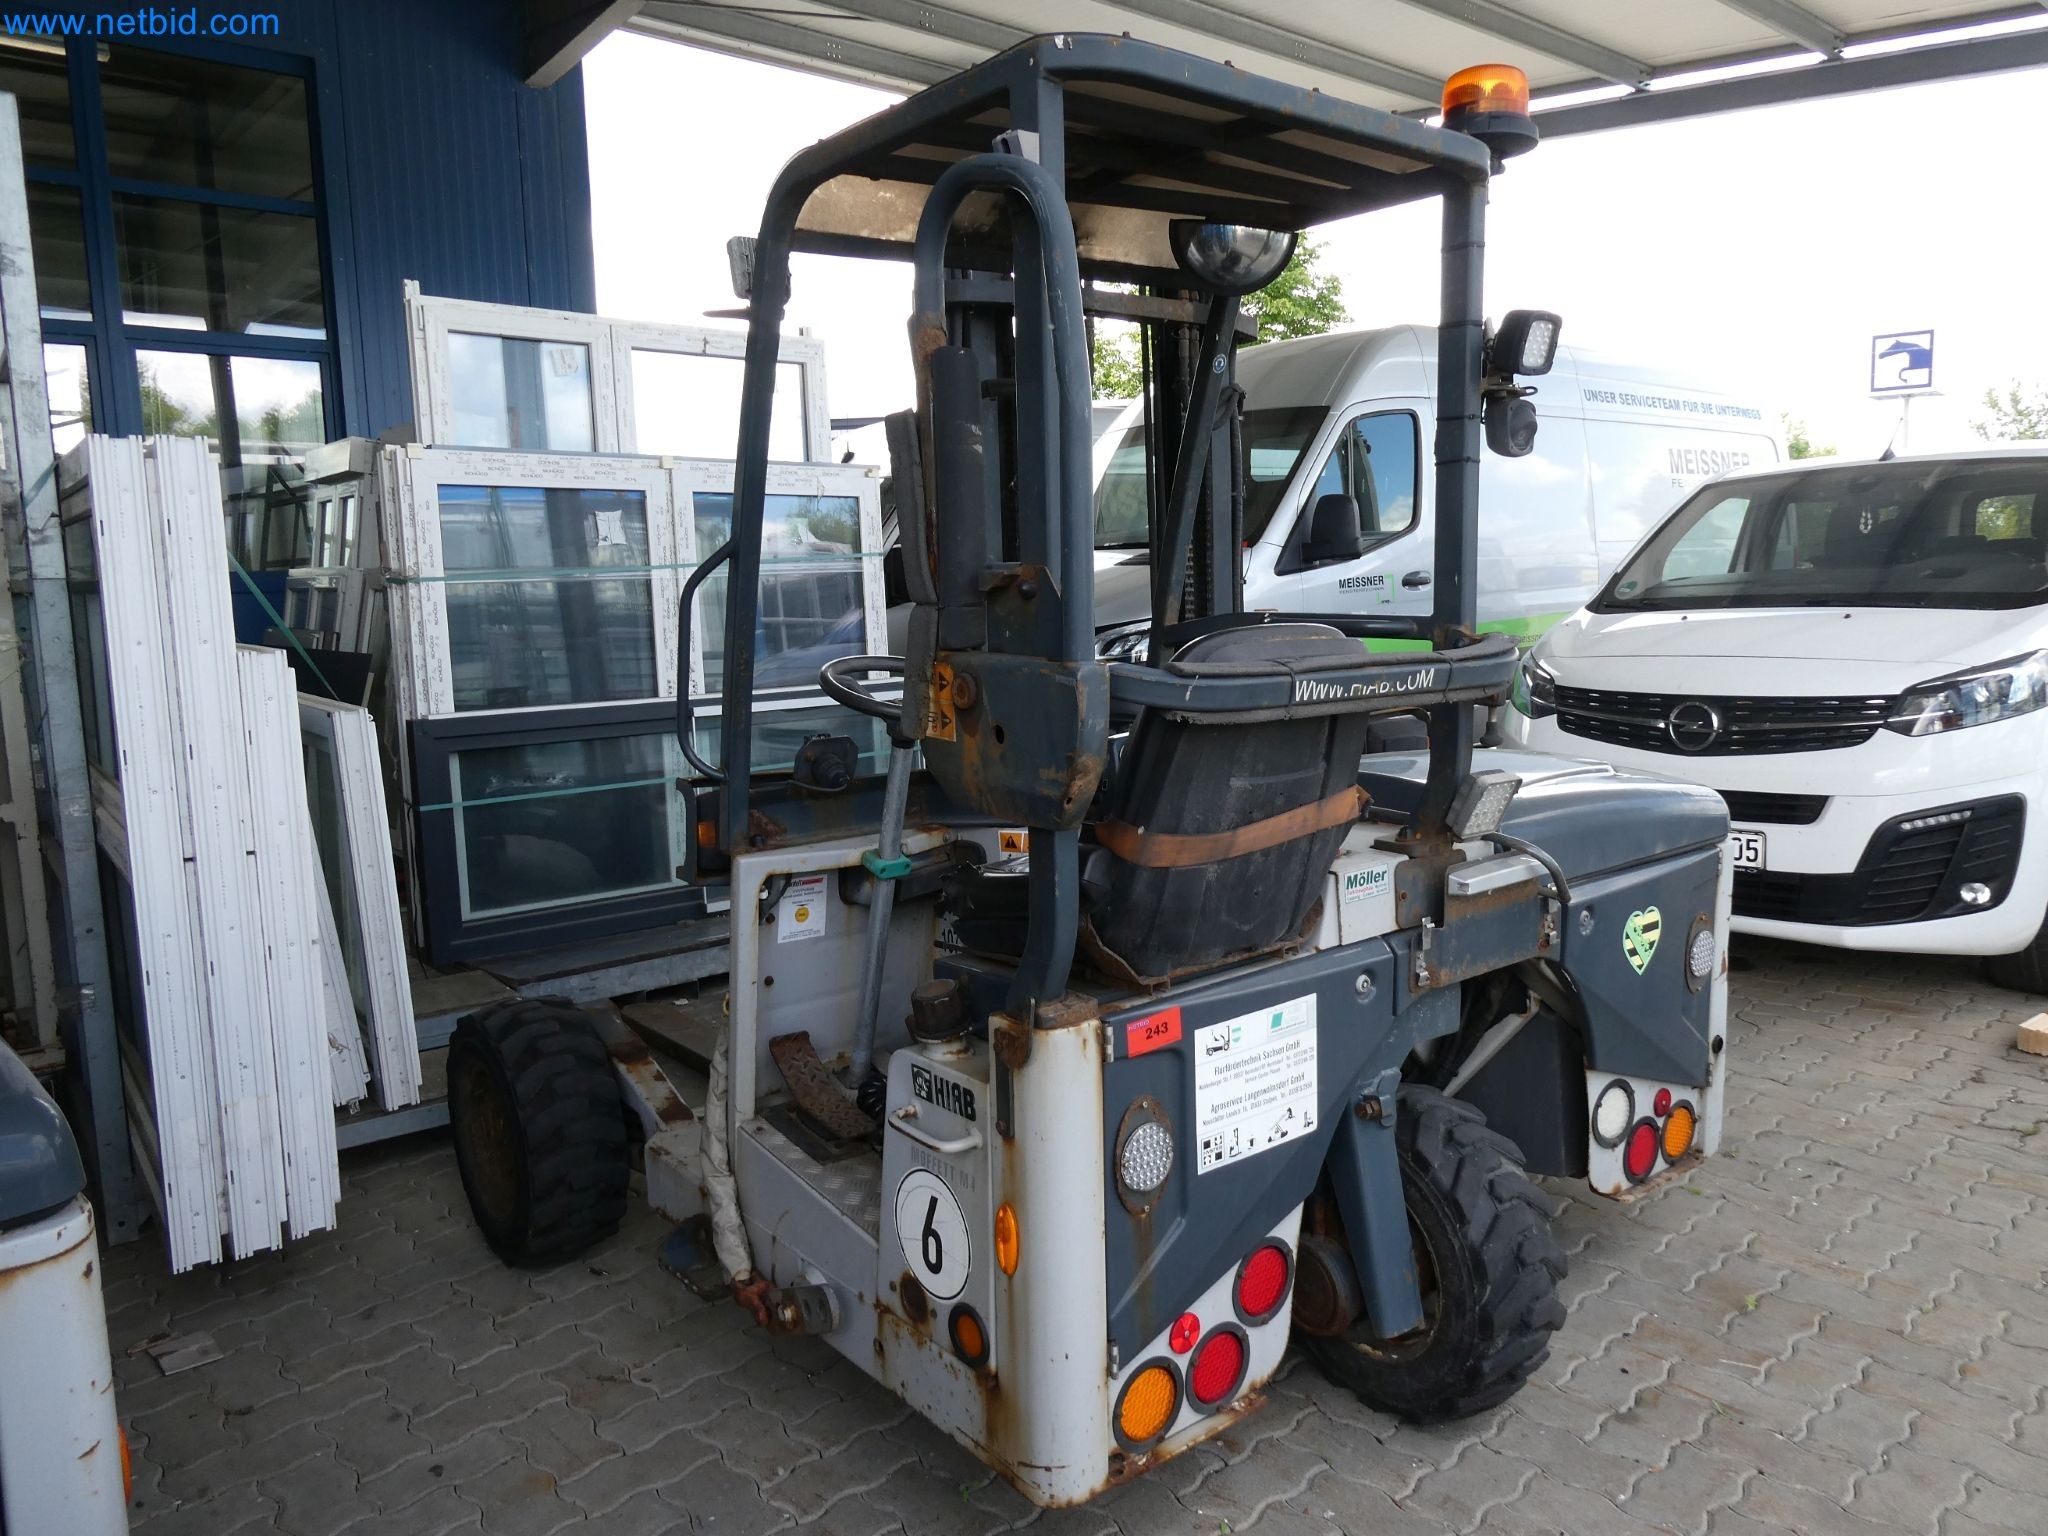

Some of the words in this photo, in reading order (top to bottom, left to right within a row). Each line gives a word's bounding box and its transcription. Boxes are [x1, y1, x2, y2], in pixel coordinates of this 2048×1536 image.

[1584, 389, 1617, 404] UNSER
[1619, 393, 1681, 411] SERVICETEAM
[1701, 402, 1713, 414] SIE
[1715, 405, 1762, 420] UNTERWEGS
[1338, 575, 1384, 589] MEISSNER
[1346, 869, 1388, 890] Möller
[1145, 1021, 1169, 1040] 243
[1263, 1044, 1284, 1060] Sachsen
[1285, 1039, 1300, 1052] GmbH
[933, 1074, 977, 1122] HIAB
[1210, 1093, 1242, 1115] Agroservice
[1290, 1071, 1304, 1085] GmbH
[922, 1195, 942, 1274] 6
